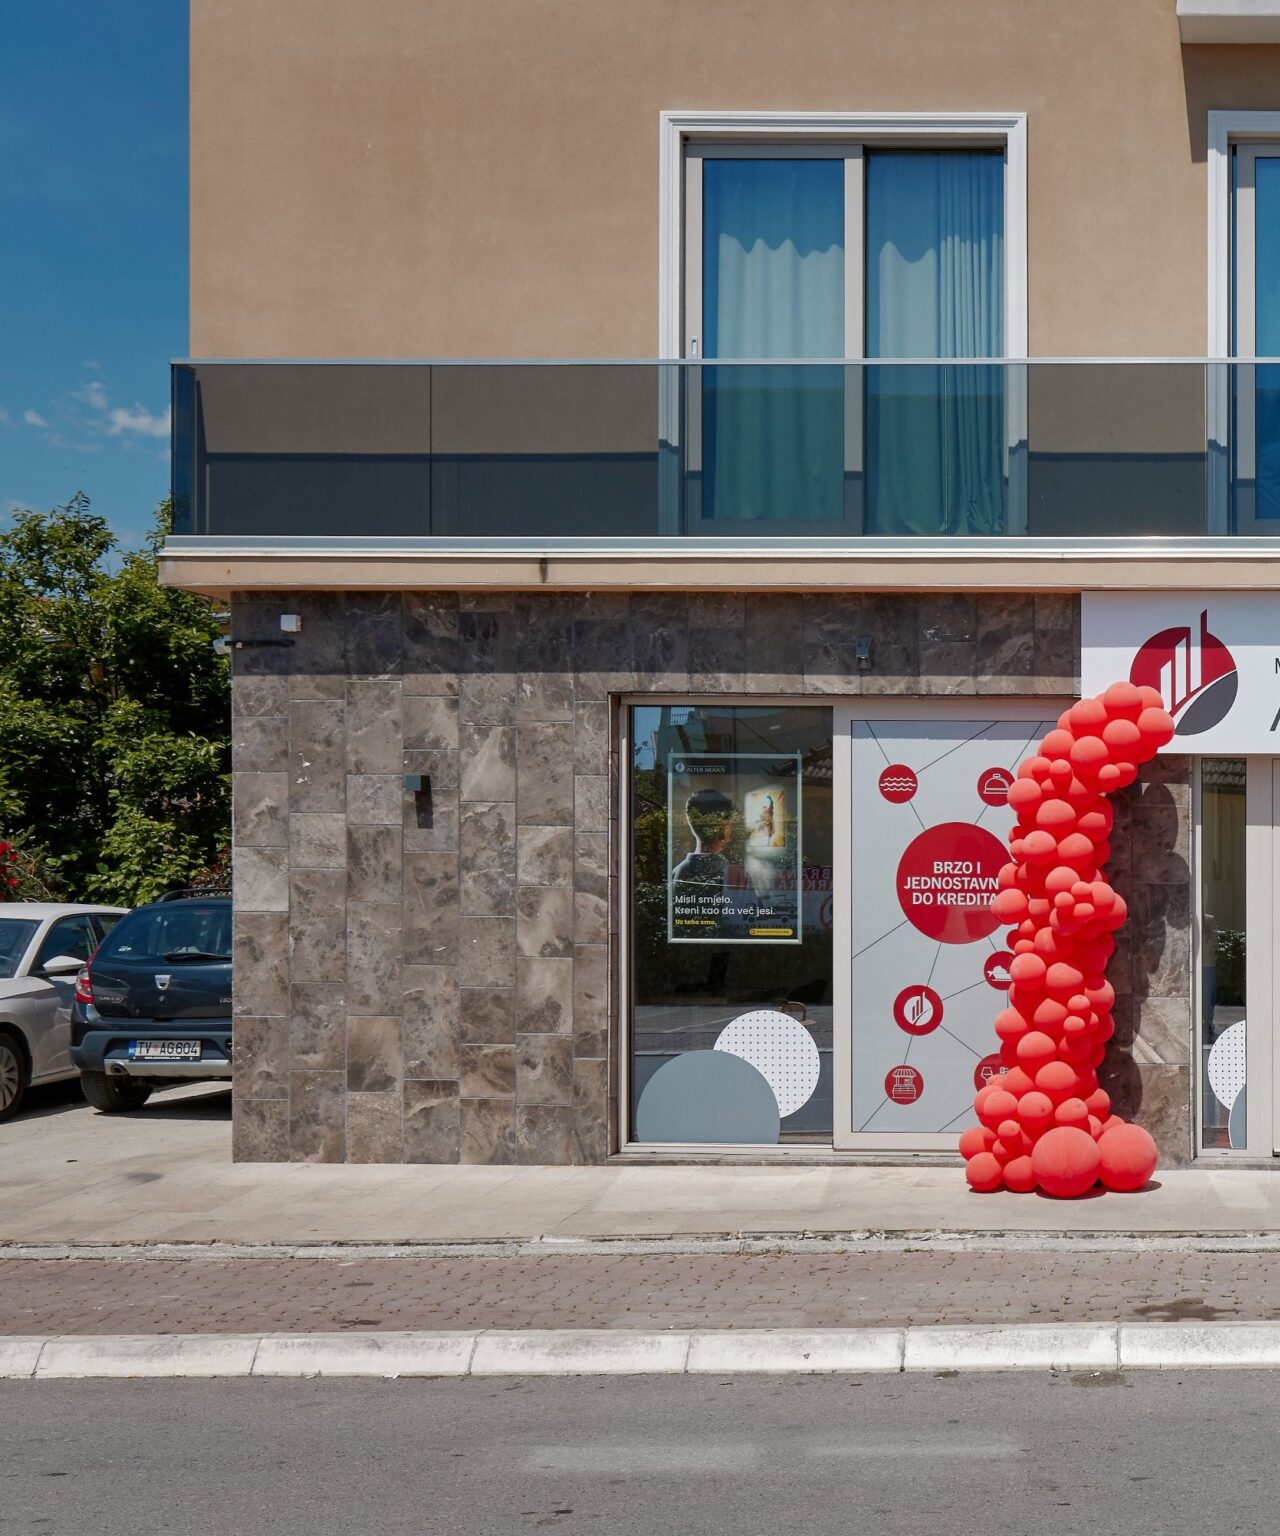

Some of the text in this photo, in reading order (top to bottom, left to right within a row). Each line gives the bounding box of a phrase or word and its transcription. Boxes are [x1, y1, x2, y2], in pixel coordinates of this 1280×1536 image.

[933, 861, 981, 874] BRZO I
[904, 877, 999, 890] JEDNOSTAVN
[675, 895, 733, 907] Misli smjelo.
[912, 893, 933, 905] DO
[675, 906, 776, 918] Kreni kao da već jesi.
[138, 1041, 198, 1055] TV AG604
